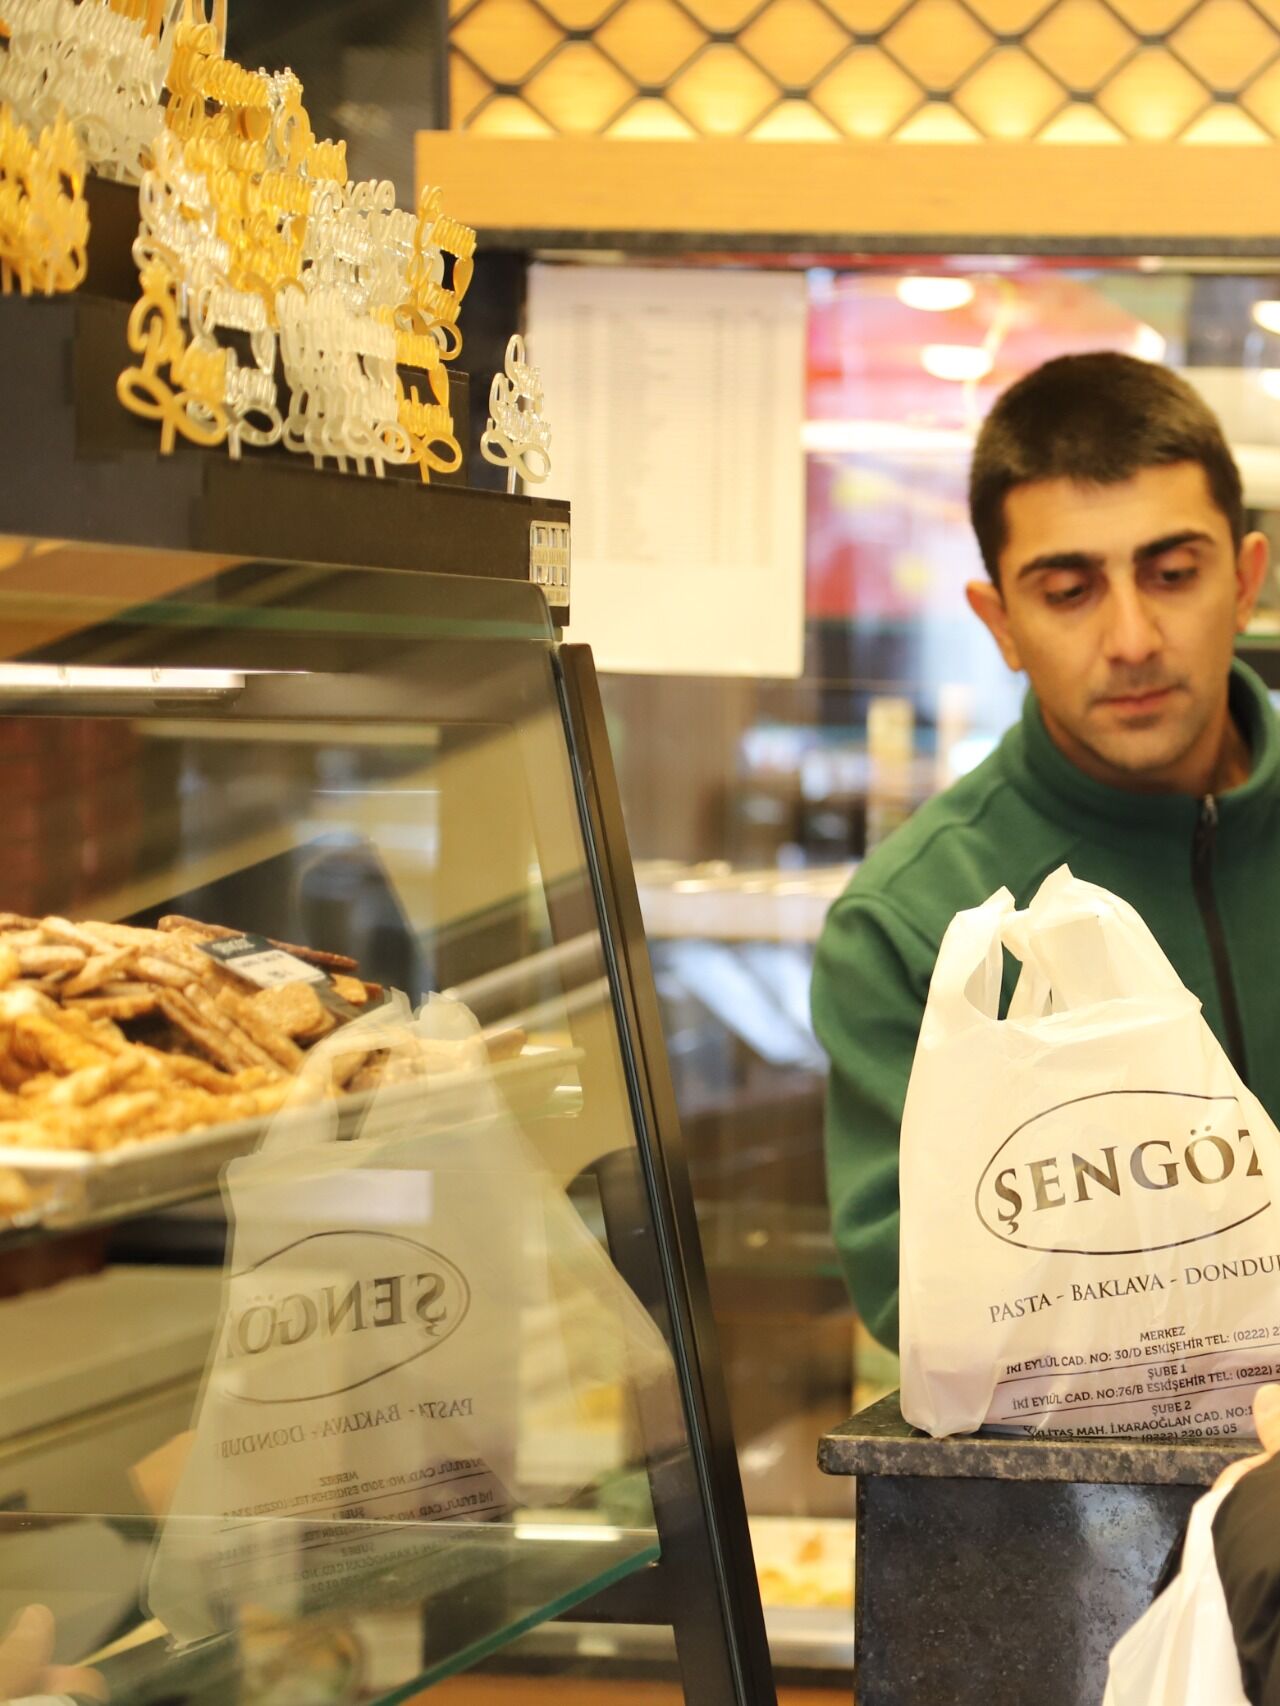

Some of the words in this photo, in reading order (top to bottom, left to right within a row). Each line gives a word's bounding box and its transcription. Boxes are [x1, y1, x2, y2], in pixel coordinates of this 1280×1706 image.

[990, 1293, 1052, 1324] PASTA
[1071, 1272, 1165, 1302] BAKLAVA
[1140, 1326, 1186, 1343] MERKEZ
[1025, 1355, 1060, 1371] EYLÜL
[1061, 1355, 1087, 1367] CAD.
[1090, 1352, 1112, 1364] NO:
[1114, 1347, 1142, 1361] 30/D
[1145, 1338, 1204, 1357] ESKİŞEHİR
[1205, 1334, 1230, 1347] TEL:
[1233, 1326, 1270, 1343] (0222)
[1147, 1364, 1178, 1380] ŞUBE
[1181, 1363, 1187, 1374] 1
[1012, 1397, 1029, 1411] İKİ
[1064, 1391, 1094, 1404] CAD.
[1096, 1384, 1144, 1400] NO:76/B
[1147, 1373, 1206, 1393] ESKİŞEHİR
[1208, 1371, 1233, 1383] TEL:
[1236, 1364, 1273, 1380] (0222)
[1151, 1402, 1182, 1416] ŞUBE
[1184, 1400, 1192, 1411] 2
[1077, 1425, 1108, 1437] MAH.
[1194, 1409, 1223, 1424] CAD.
[1181, 1425, 1203, 1438] 220
[1205, 1424, 1221, 1437] 03
[1223, 1423, 1238, 1435] 05
